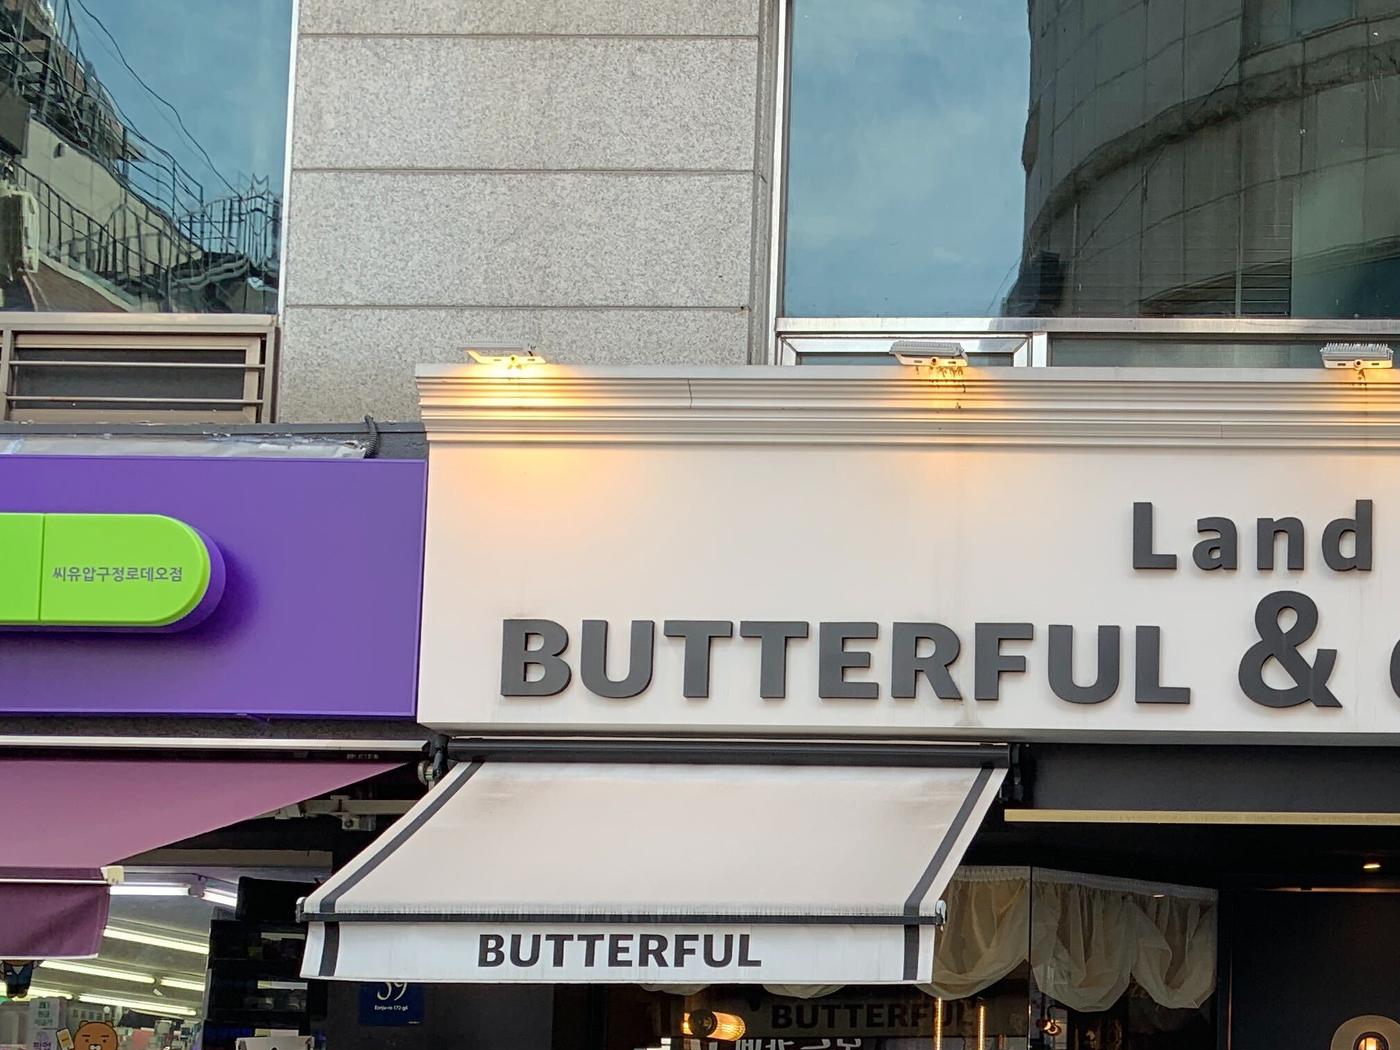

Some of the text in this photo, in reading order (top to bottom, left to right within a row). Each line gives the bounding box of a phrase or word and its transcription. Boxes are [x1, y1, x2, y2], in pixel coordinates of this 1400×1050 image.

[1132, 499, 1374, 575] Land
[52, 566, 184, 583] 씨유압구정로데오점
[500, 618, 1191, 706] BUTTERFUL
[1237, 590, 1344, 710] &
[477, 933, 762, 968] BUTTERFUL
